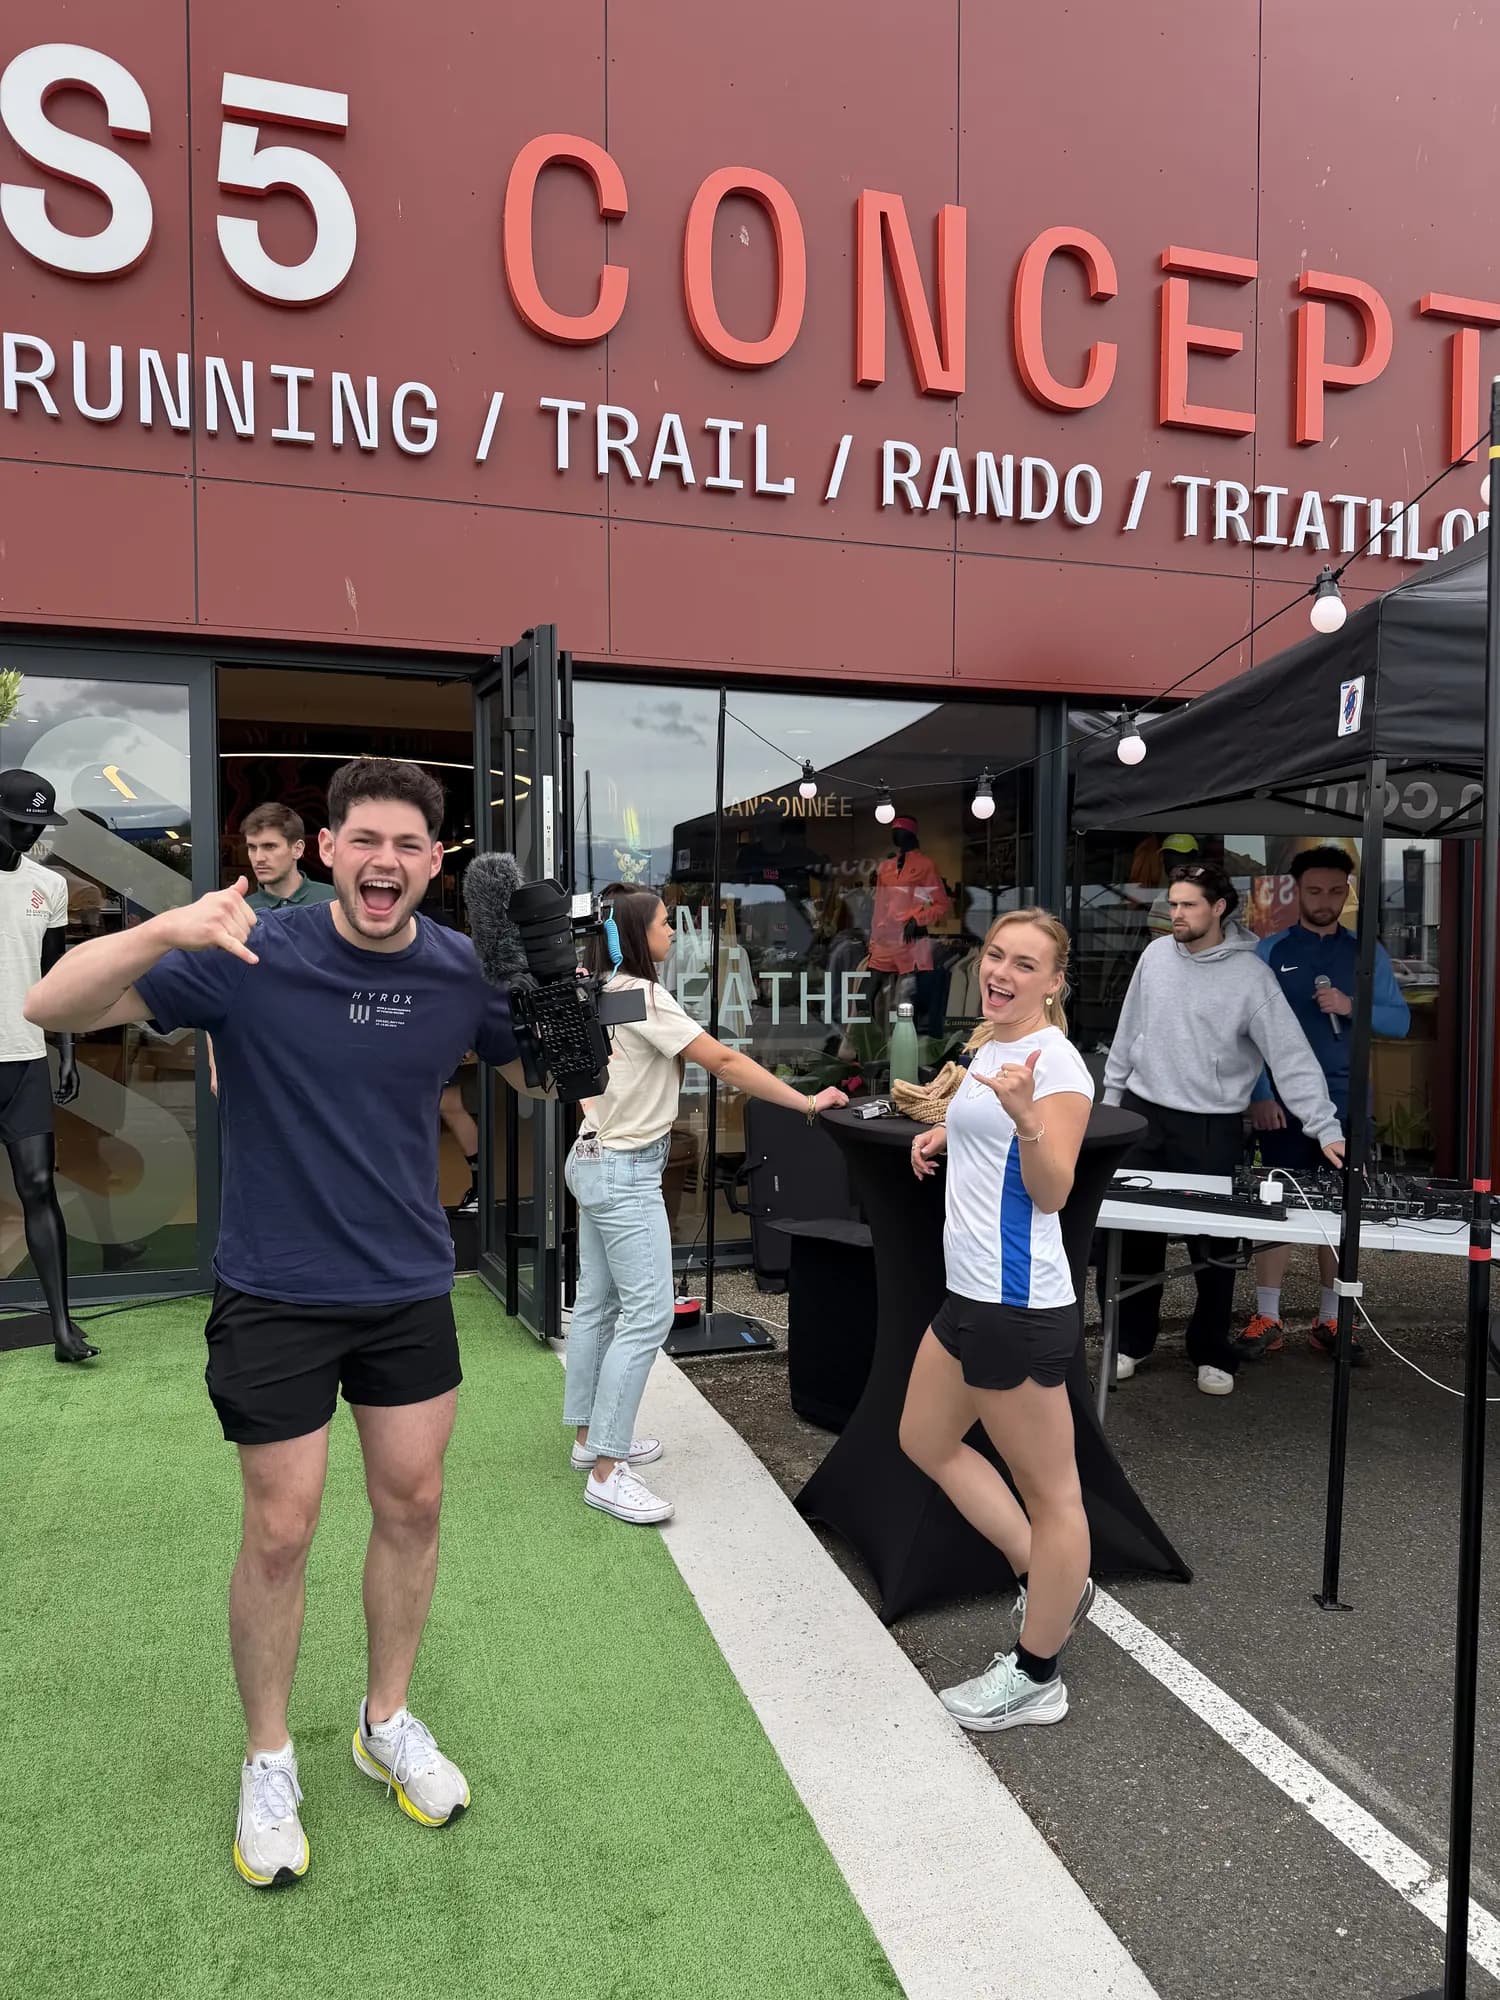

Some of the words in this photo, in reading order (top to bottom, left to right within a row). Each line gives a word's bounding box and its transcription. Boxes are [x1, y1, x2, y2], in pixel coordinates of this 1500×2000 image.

[0, 43, 357, 307] S5
[503, 133, 1500, 464] CONCEPT
[2, 331, 439, 457] RUNNING
[539, 396, 796, 496] TRAIL
[881, 439, 1104, 527] RANDO
[1172, 474, 1490, 561] TRIATHLO
[351, 991, 413, 1005] HYROX
[675, 971, 898, 1026] EATHE.
